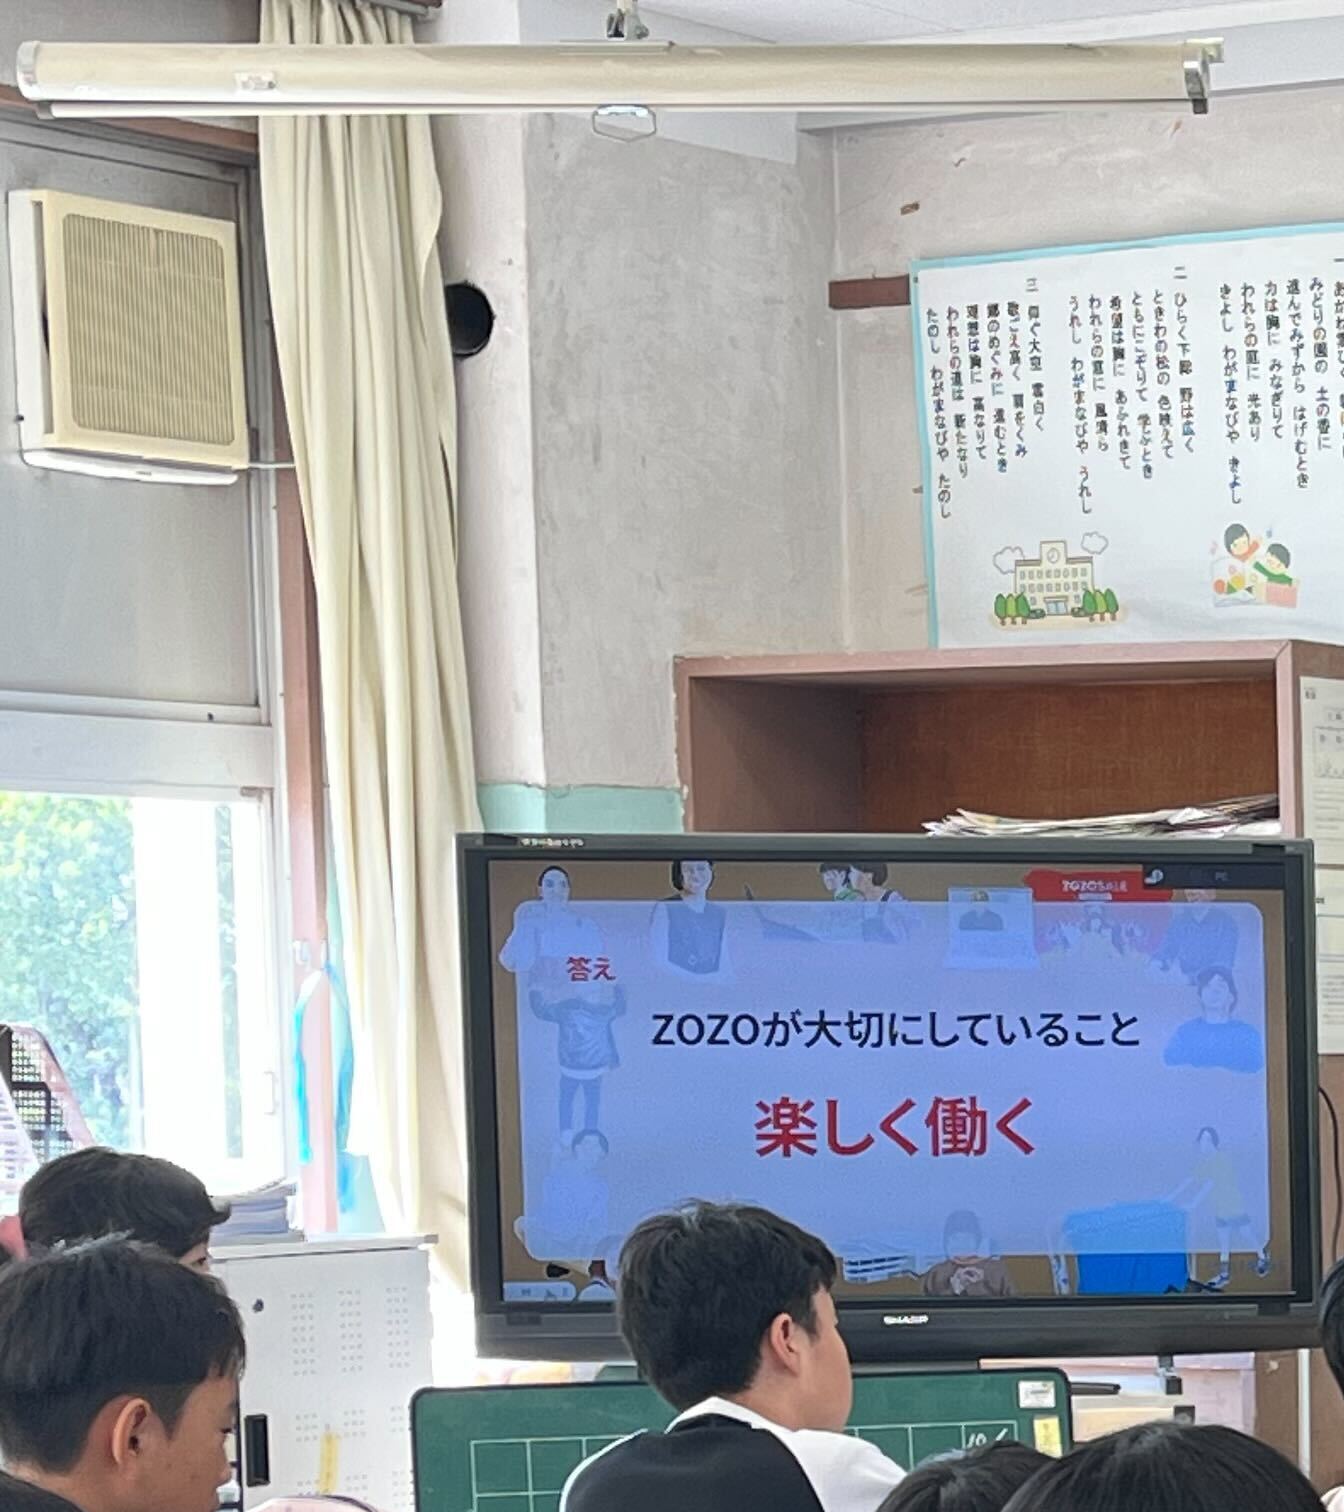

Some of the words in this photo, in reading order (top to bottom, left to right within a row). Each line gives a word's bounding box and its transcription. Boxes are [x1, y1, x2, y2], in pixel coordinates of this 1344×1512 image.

[1173, 266, 1187, 279] 二
[926, 308, 940, 354] たのし
[1069, 295, 1082, 344] うれし
[1220, 284, 1234, 333] きよし
[1287, 279, 1306, 393] 進んでみずから
[930, 365, 949, 461] わがまなびや
[1070, 357, 1088, 454] わがまなびや
[1222, 345, 1241, 443] わがまなびや
[1269, 359, 1285, 439] みなぎりて
[1293, 406, 1309, 488] はげむとき
[938, 473, 951, 519] たのし
[1078, 465, 1092, 514] うれし
[1229, 456, 1242, 505] きよし
[566, 955, 616, 983] 答え
[651, 1008, 1142, 1049] ZOZOが大切にしていること
[754, 1095, 1037, 1159] 楽しく働く
